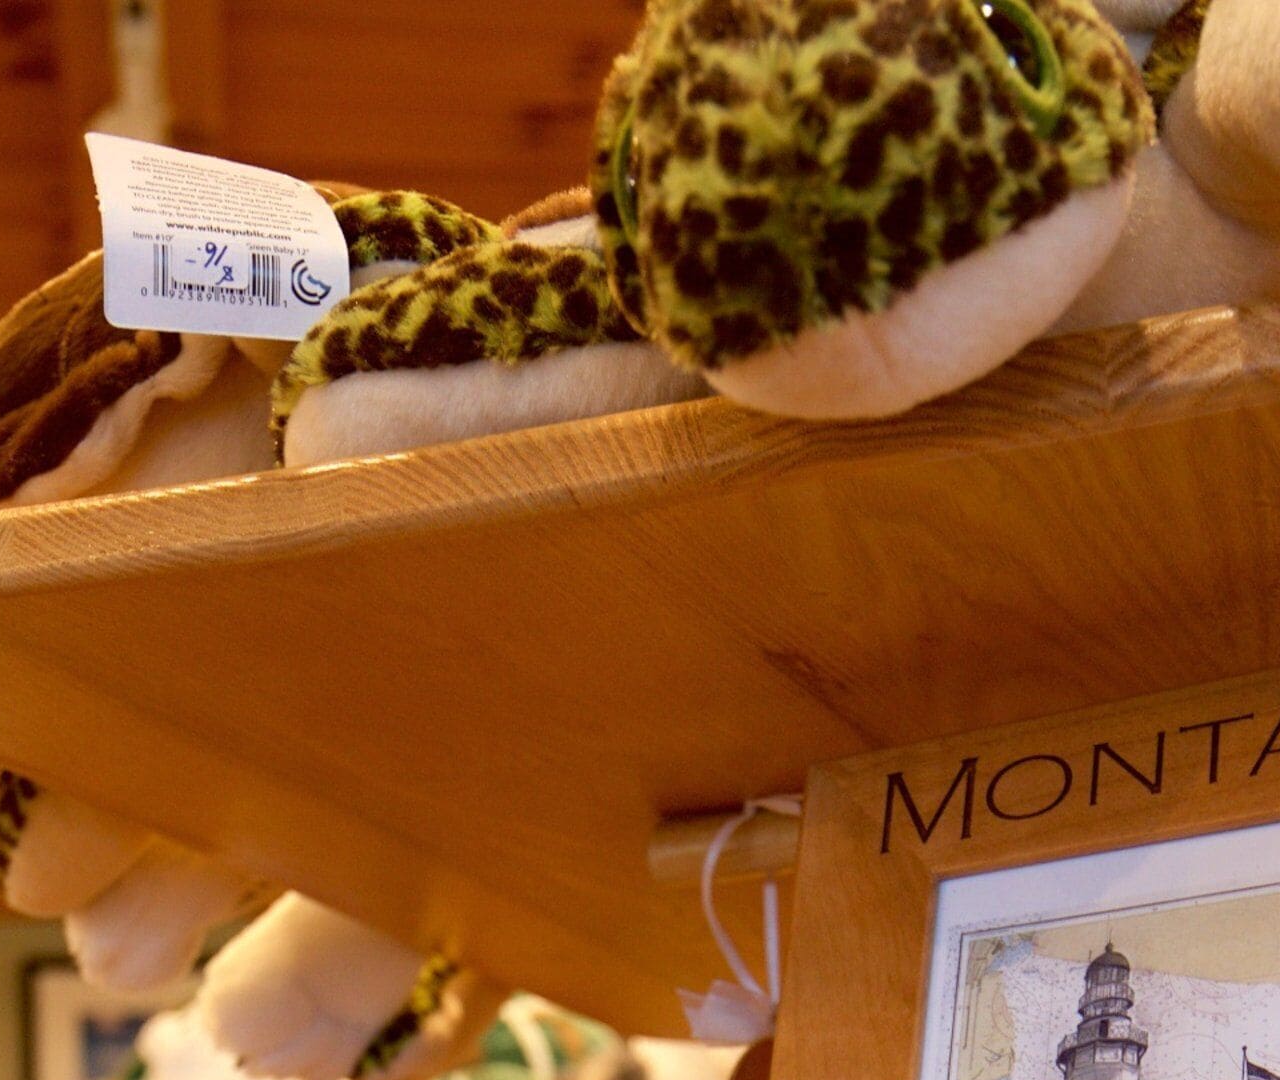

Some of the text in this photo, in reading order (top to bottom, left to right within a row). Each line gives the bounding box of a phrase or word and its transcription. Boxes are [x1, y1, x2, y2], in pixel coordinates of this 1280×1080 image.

[133, 231, 153, 241] Item
[166, 221, 291, 242] www.wildrepublic.com
[141, 287, 148, 297] 0
[282, 300, 288, 309] 1
